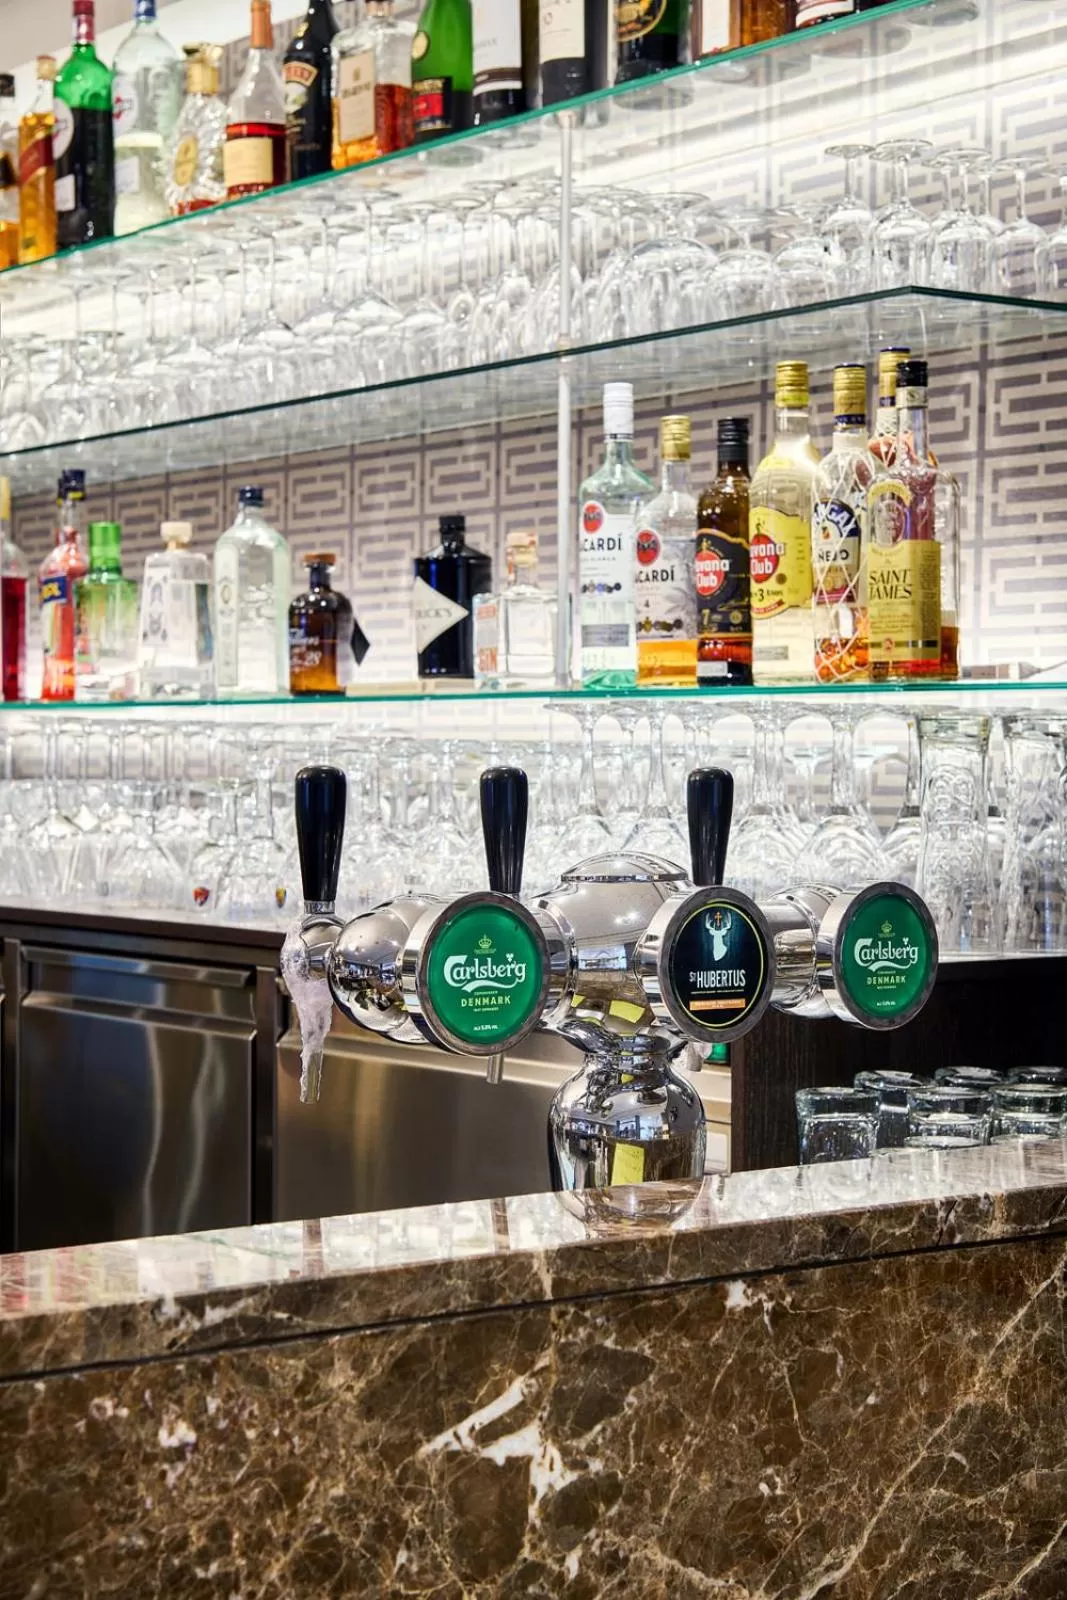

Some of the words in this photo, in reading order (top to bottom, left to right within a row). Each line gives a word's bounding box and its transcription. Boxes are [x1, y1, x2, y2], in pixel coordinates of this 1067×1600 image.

[869, 569, 912, 585] SAINT
[758, 588, 765, 602] 3
[869, 585, 912, 600] JAMES
[701, 610, 710, 625] 7
[854, 937, 919, 972] Carlsberg
[443, 953, 527, 993] Carlsberg
[697, 969, 746, 988] HUBERTUS
[866, 975, 906, 985] DENMARK
[461, 995, 511, 1007] DENMARK
